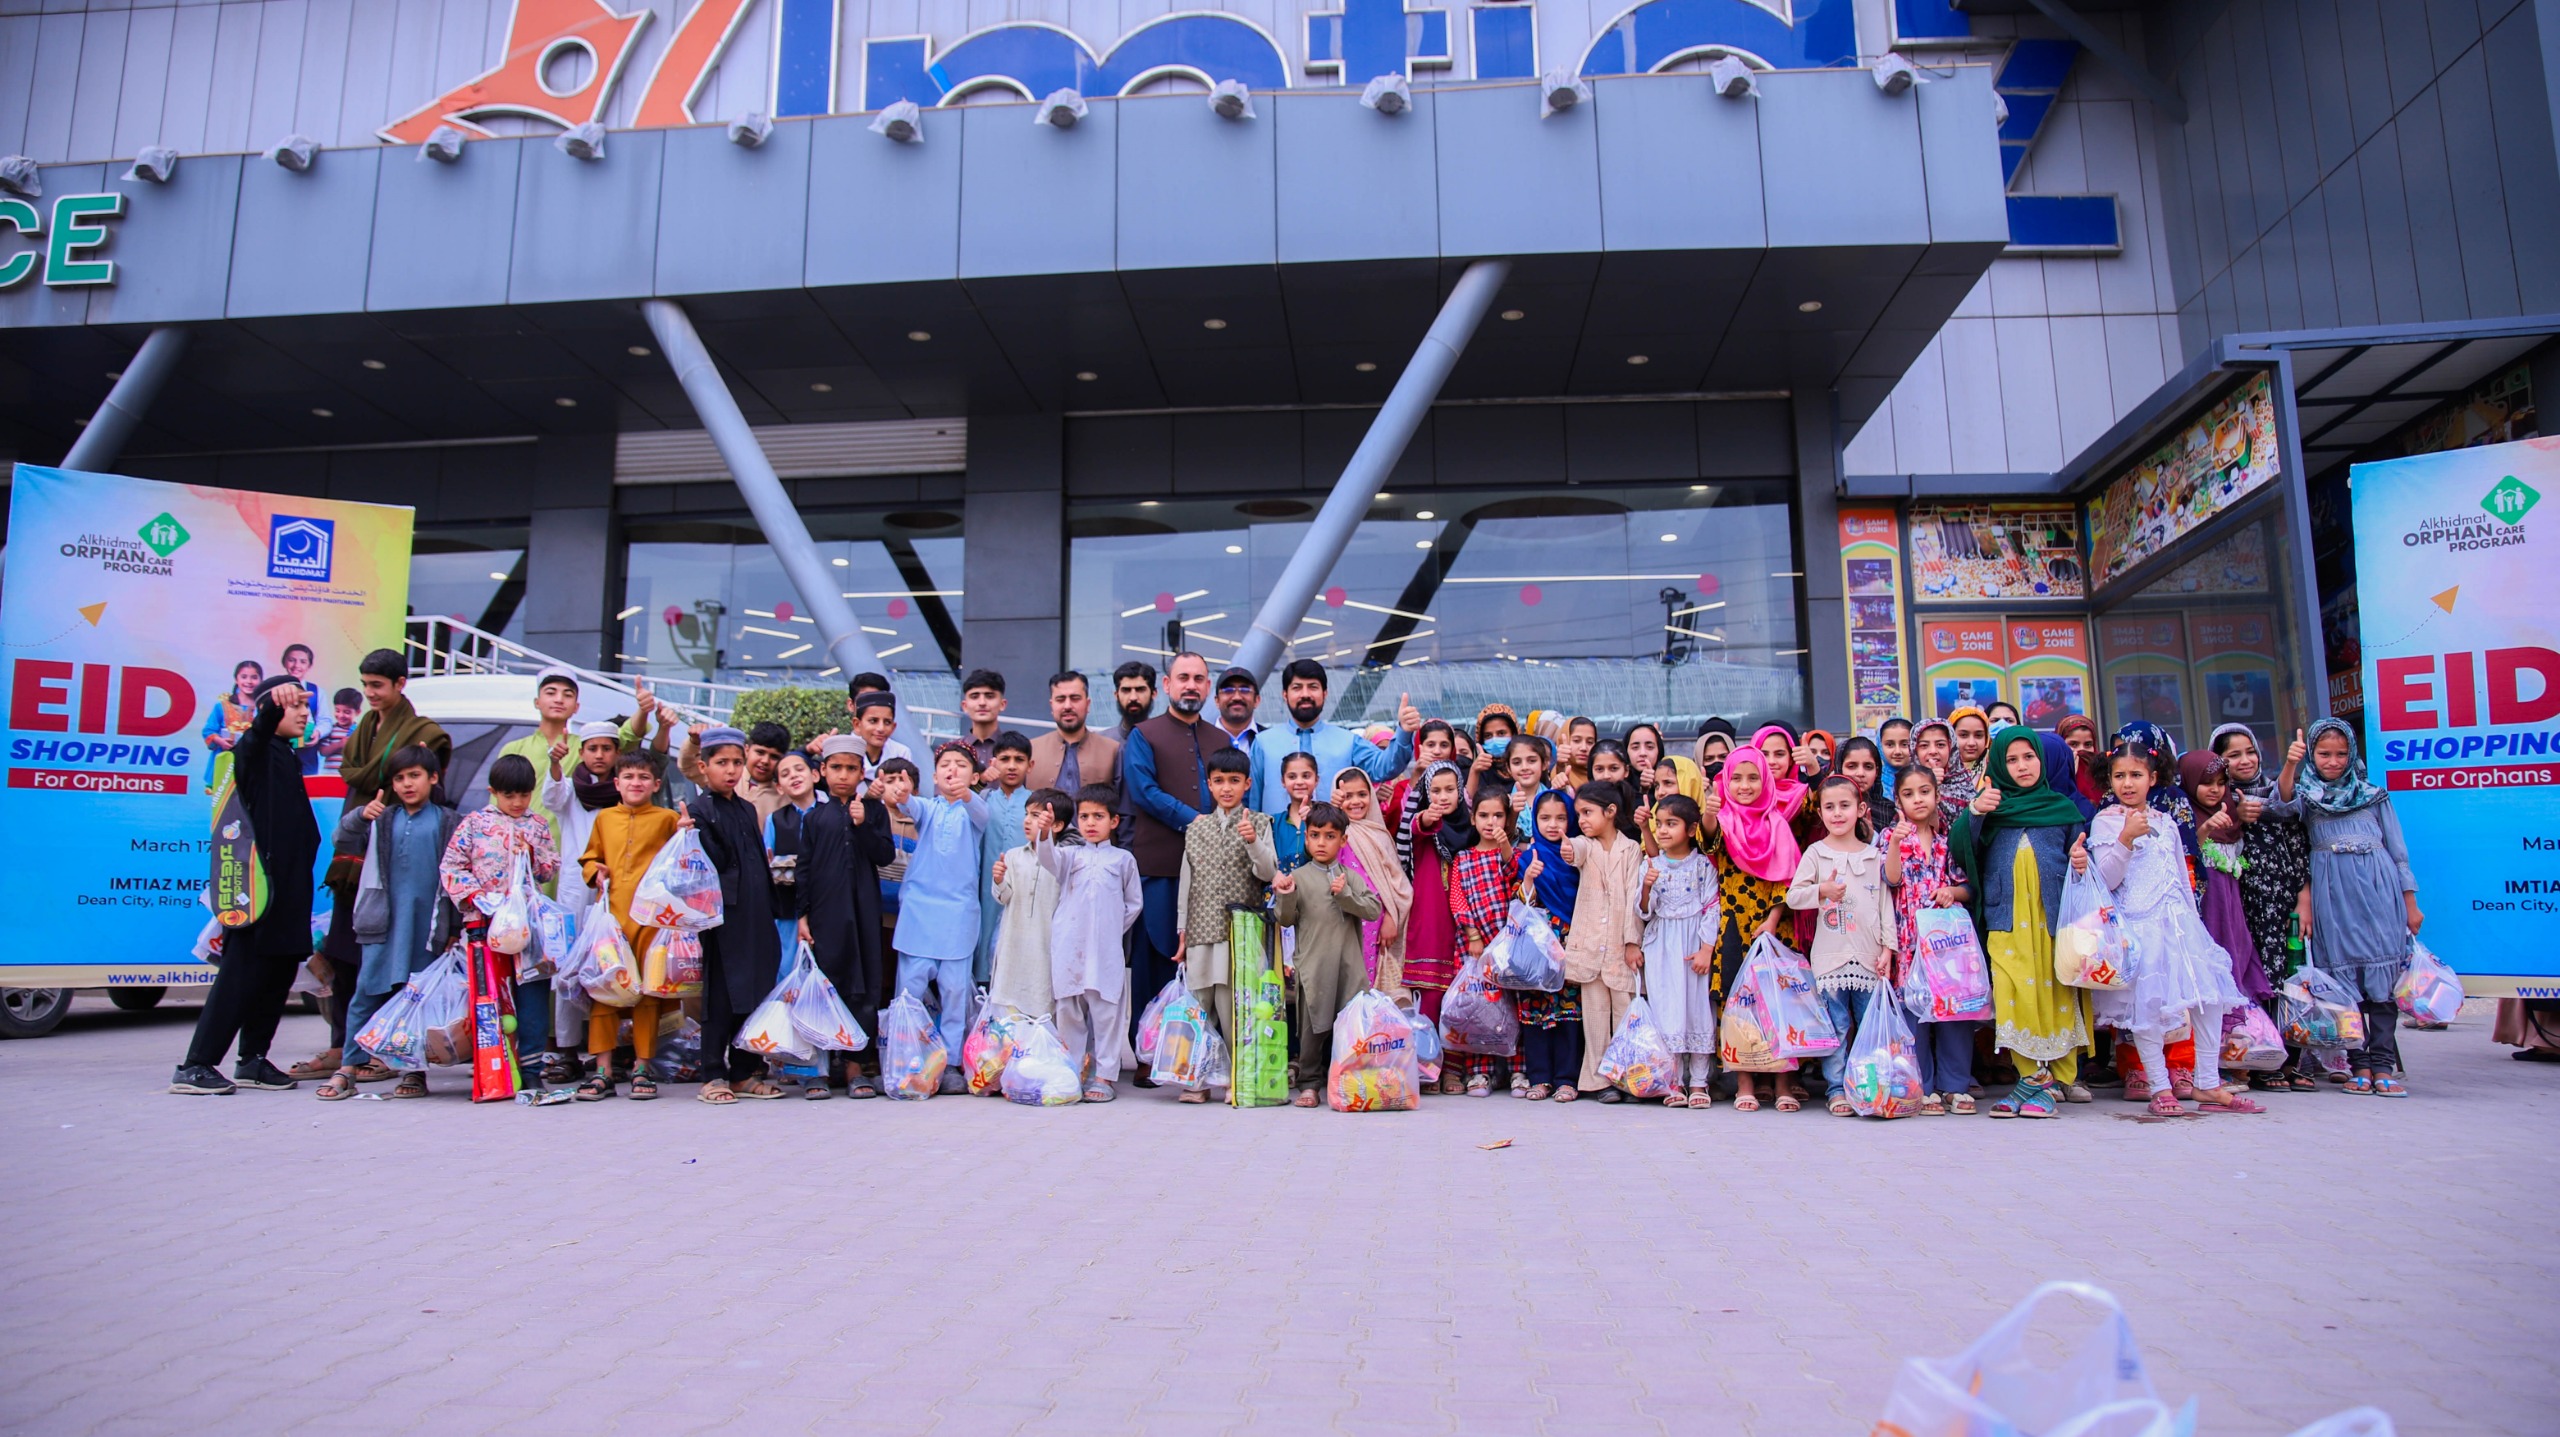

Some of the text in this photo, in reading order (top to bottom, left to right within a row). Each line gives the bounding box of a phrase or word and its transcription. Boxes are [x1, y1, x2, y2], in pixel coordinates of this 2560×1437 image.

[2419, 513, 2486, 531] Alkhidmat
[78, 533, 143, 550] Alkhidmat
[2403, 523, 2525, 547] ORPHAN CARE
[2449, 534, 2526, 552] PROGRAM
[60, 543, 174, 566] ORPHAN CARE
[103, 561, 173, 576] PROGRAM
[272, 565, 327, 578] ALKHIDMAT
[1961, 631, 1993, 641] GAME
[2042, 628, 2075, 638] GAME
[1962, 641, 1993, 651] ZONE
[2044, 638, 2075, 648] ZONE
[9, 658, 197, 737] EID
[2376, 646, 2560, 732] EID
[2332, 693, 2363, 715] ZONE
[10, 738, 191, 767] SHOPPING
[34, 772, 165, 792] For Orphans
[2412, 768, 2552, 789] For Orphans
[131, 838, 190, 853] March
[110, 878, 172, 891] IMTIAZ
[77, 895, 117, 906] Dean
[122, 895, 154, 908] City,
[159, 895, 192, 908] Ring
[2472, 899, 2559, 913] Dean City,
[1929, 933, 1969, 951] Imtiaz
[1369, 1038, 1405, 1053] Imtiaz
